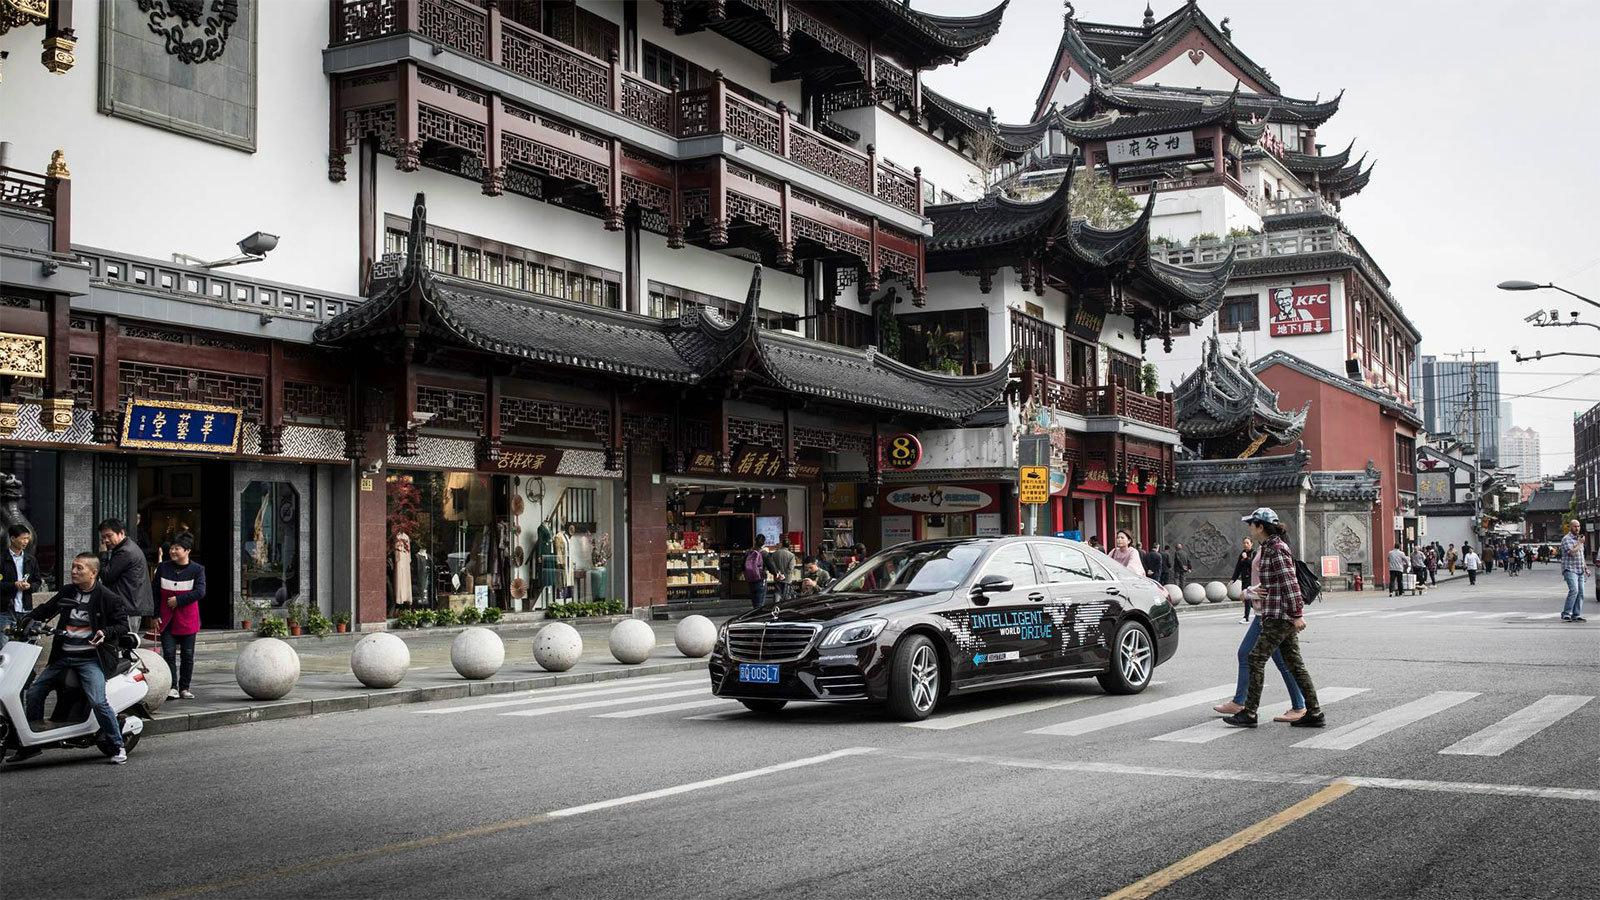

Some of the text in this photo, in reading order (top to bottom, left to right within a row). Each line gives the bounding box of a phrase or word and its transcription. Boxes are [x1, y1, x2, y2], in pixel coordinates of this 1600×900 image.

[1295, 293, 1328, 306] KFC
[1277, 322, 1312, 334] 地下1层
[497, 451, 546, 470] 吉祥衣家
[971, 611, 1043, 629] INTELLIGENT
[999, 624, 1052, 640] WORLD DRIVE
